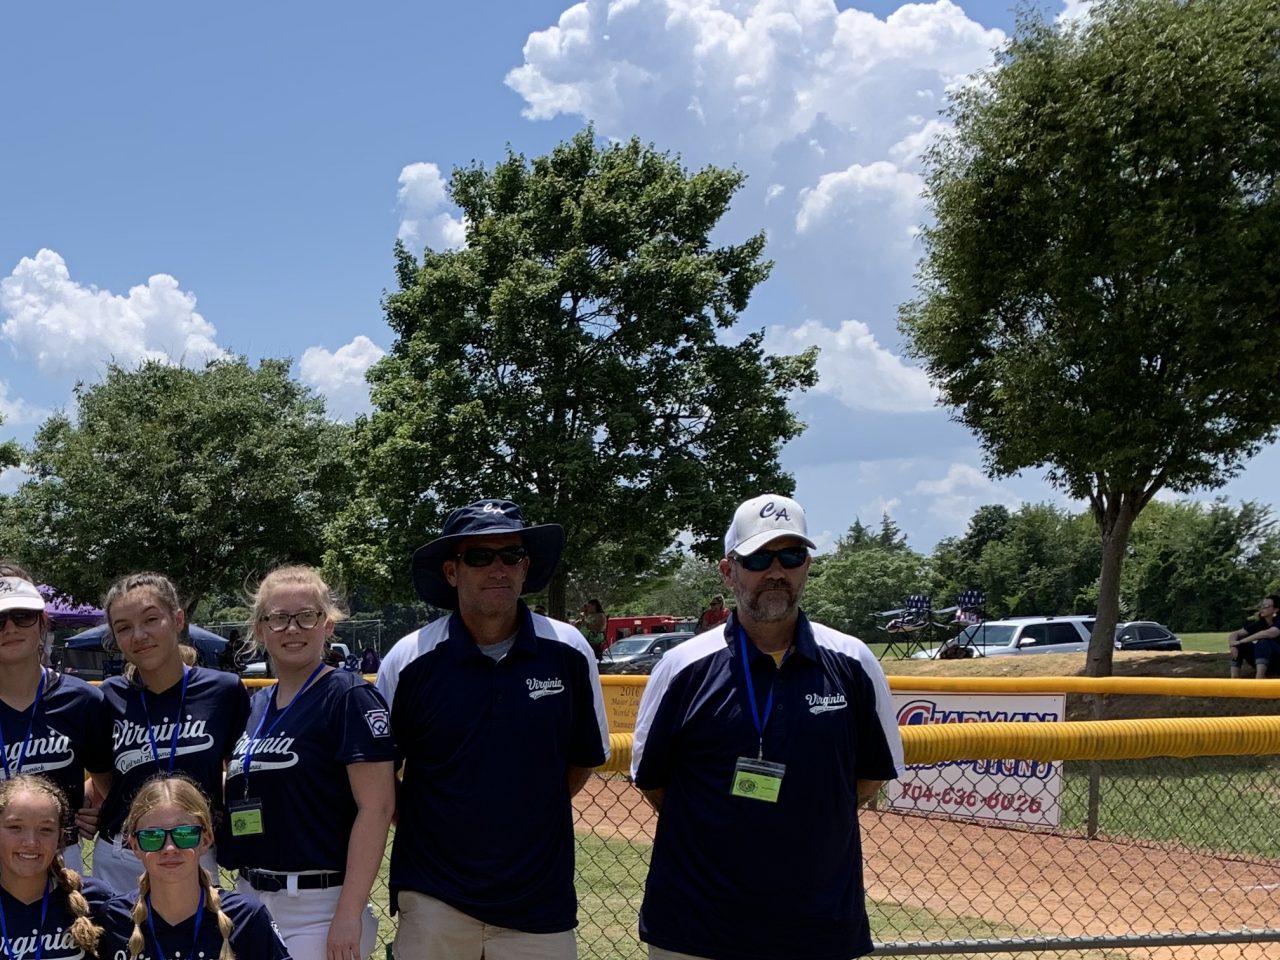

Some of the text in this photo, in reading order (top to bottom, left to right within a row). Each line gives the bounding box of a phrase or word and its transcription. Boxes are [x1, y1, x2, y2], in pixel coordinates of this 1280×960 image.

[760, 502, 791, 521] CA
[525, 677, 562, 691] Virginia
[805, 693, 845, 707] Virginia
